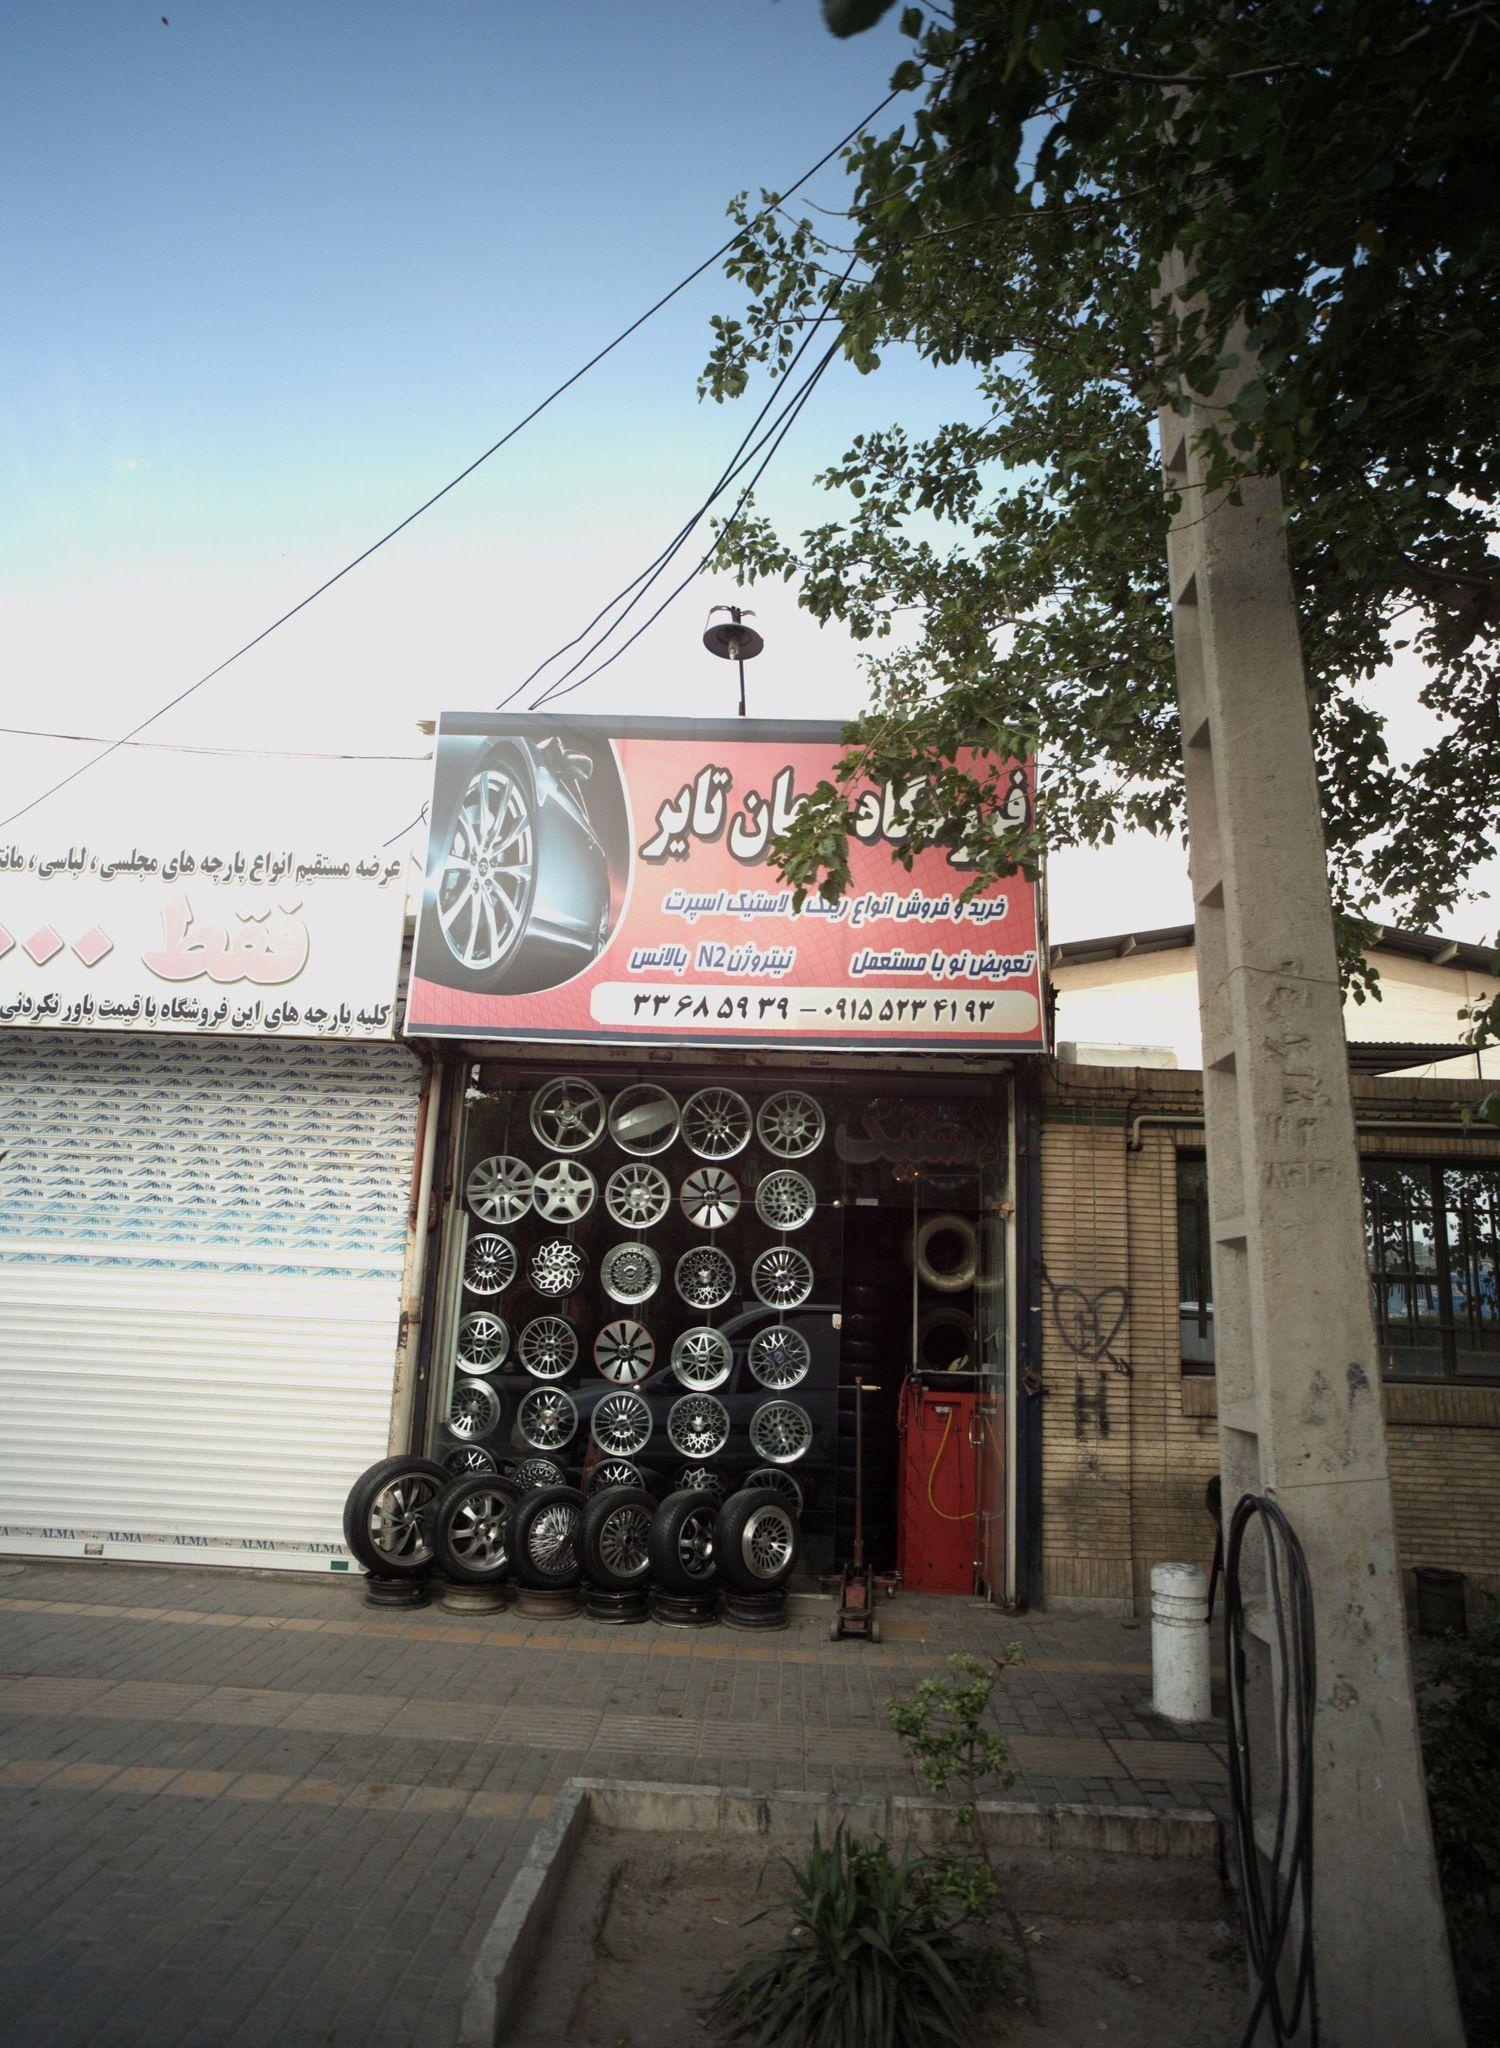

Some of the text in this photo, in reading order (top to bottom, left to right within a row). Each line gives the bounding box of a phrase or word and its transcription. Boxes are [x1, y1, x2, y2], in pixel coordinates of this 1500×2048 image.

[640, 766, 731, 858] تایر
[161, 849, 196, 880] های
[199, 850, 245, 883] پارچه
[249, 851, 293, 883] انواع
[295, 853, 350, 883] مستقیم
[355, 854, 401, 886] عرضه
[664, 891, 725, 921] اسپرت
[726, 893, 790, 918] لاستیک
[851, 895, 895, 925] انواع
[896, 892, 950, 919] فروش
[968, 897, 1006, 922] خرید
[140, 895, 309, 985] فقط
[630, 945, 794, 975] نیتروژن N2 بالانس
[851, 951, 1035, 978] تعویض نو با مستعمل
[0, 992, 391, 1032] کلیه پارچه های این فروشگاه با قیمت باور نکردنی
[39, 1528, 343, 1555] ALMA ALMA ALMA ALMA ALMA
